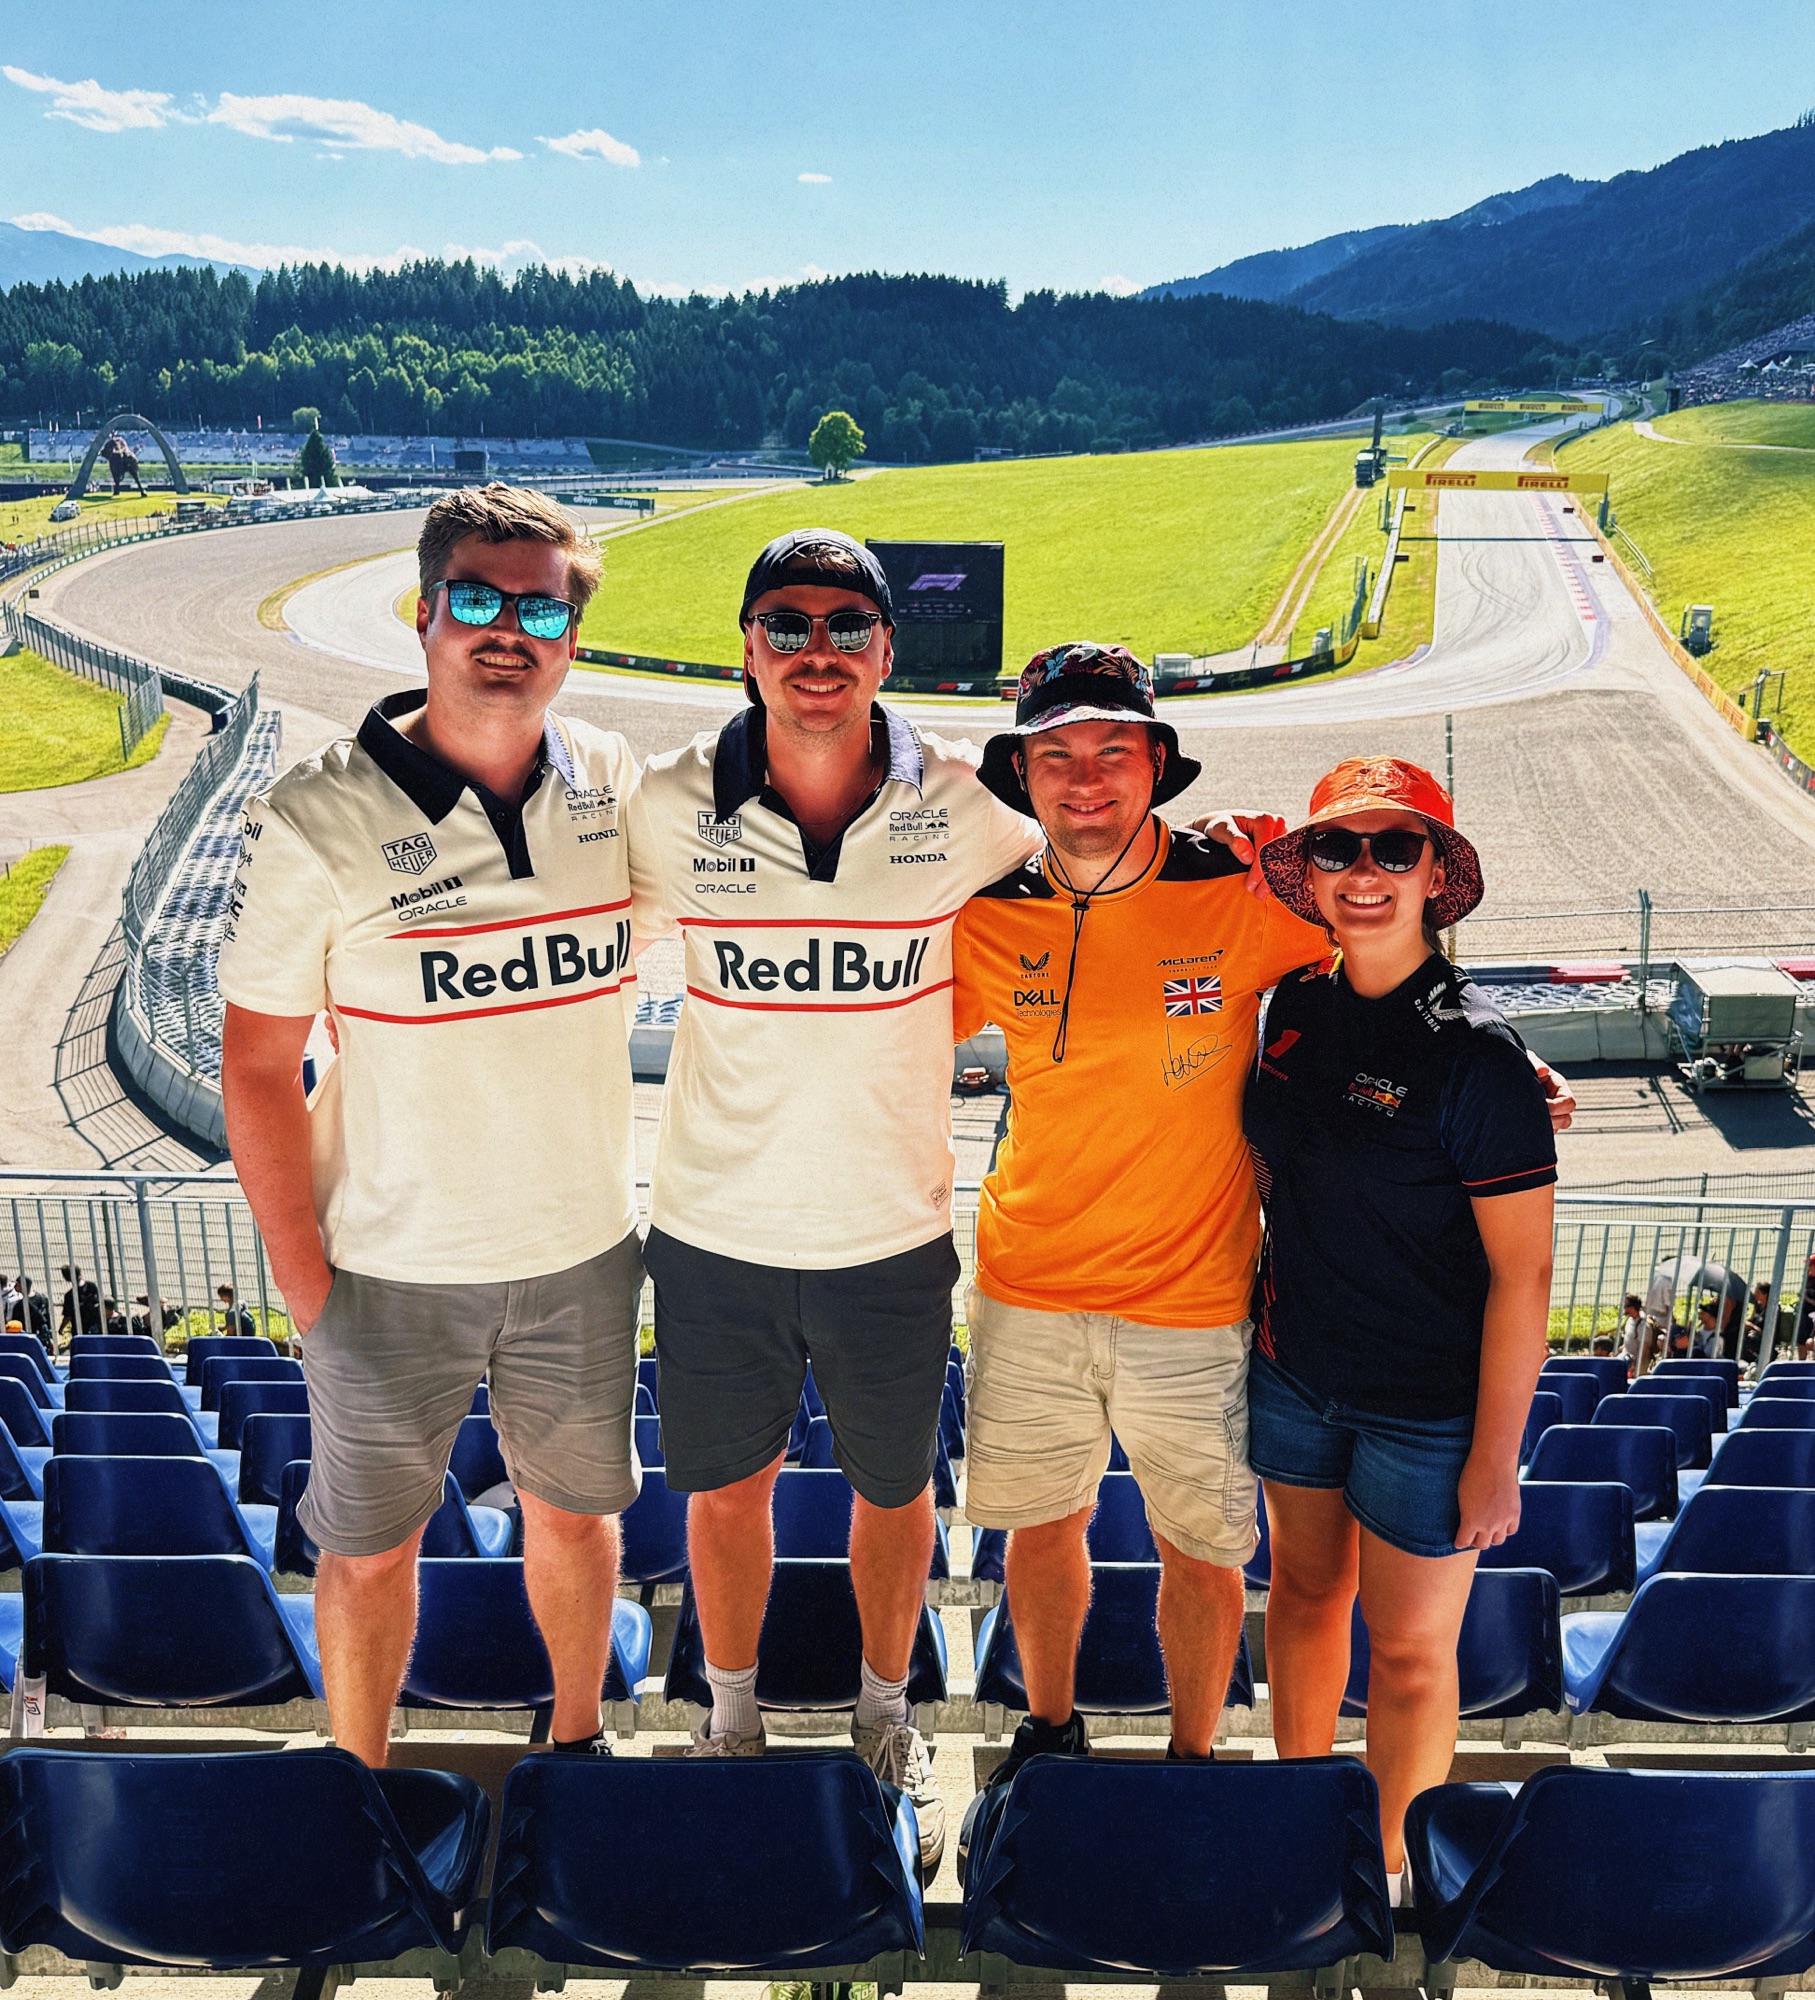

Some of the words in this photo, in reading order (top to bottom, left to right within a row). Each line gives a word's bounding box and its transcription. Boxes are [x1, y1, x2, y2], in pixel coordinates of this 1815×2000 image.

[1425, 473, 1477, 487] PIRELLI
[1517, 475, 1569, 488] PIRELLI
[908, 573, 968, 591] F1
[564, 784, 614, 800] ORACLE
[571, 809, 614, 822] RACIN
[701, 814, 737, 826] TG
[889, 808, 949, 821] ORACLE
[889, 822, 906, 832] Red
[907, 821, 923, 831] Bull
[577, 828, 619, 844] HOND
[701, 828, 739, 844] HEUER
[889, 833, 950, 842] RACING
[386, 836, 428, 856] TAG
[391, 849, 434, 872] HEUER
[693, 857, 736, 873] Mobil
[889, 852, 948, 864] HONDA
[390, 881, 443, 910] Mobil
[695, 883, 757, 894] ORACLE
[398, 895, 467, 922] ORACLE
[420, 936, 539, 1003] Red
[545, 918, 631, 986] Bull
[713, 938, 820, 992] Red
[832, 936, 930, 992] Bull
[1156, 954, 1218, 967] McLaren
[1013, 988, 1061, 1007] DELL
[1015, 1007, 1062, 1019] Technologies
[1342, 1094, 1395, 1118] ACING
